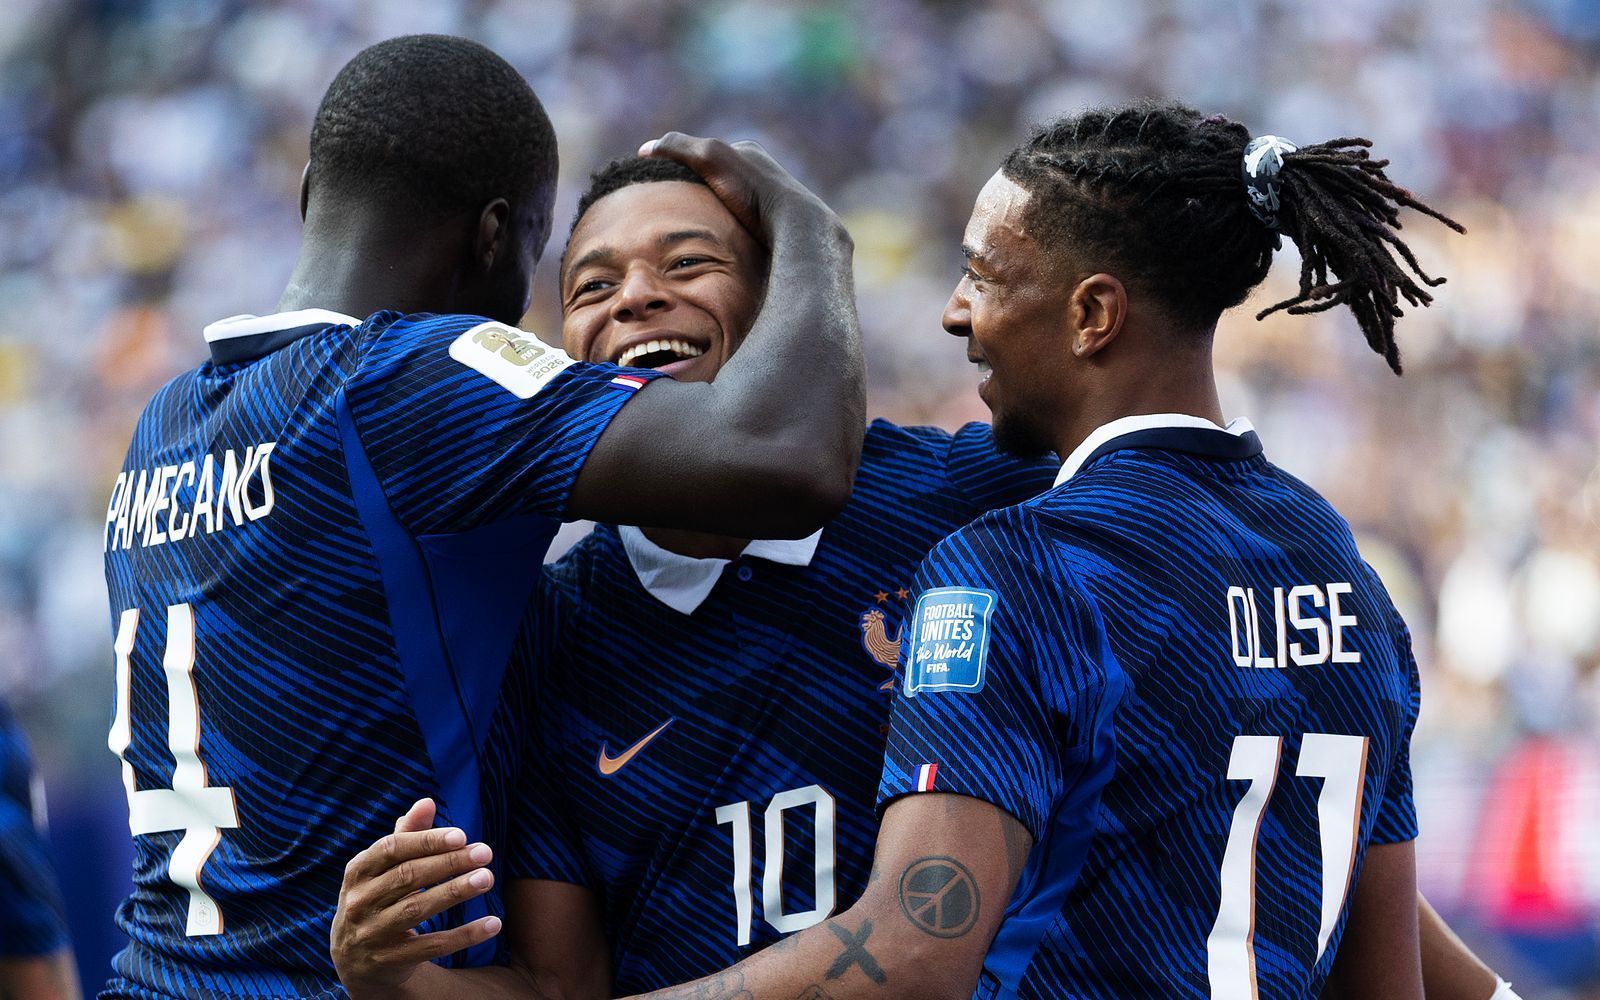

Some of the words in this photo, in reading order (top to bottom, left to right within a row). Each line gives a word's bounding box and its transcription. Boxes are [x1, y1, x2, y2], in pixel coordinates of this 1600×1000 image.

[533, 359, 564, 379] 2026
[924, 604, 974, 620] FOOTBALL
[921, 620, 974, 642] UNITES
[1226, 582, 1361, 668] OLISE
[916, 643, 932, 664] the
[934, 641, 975, 661] World
[926, 663, 949, 673] FIFA
[107, 602, 241, 936] 4
[715, 784, 837, 947] 10
[1206, 732, 1370, 1000] 11
